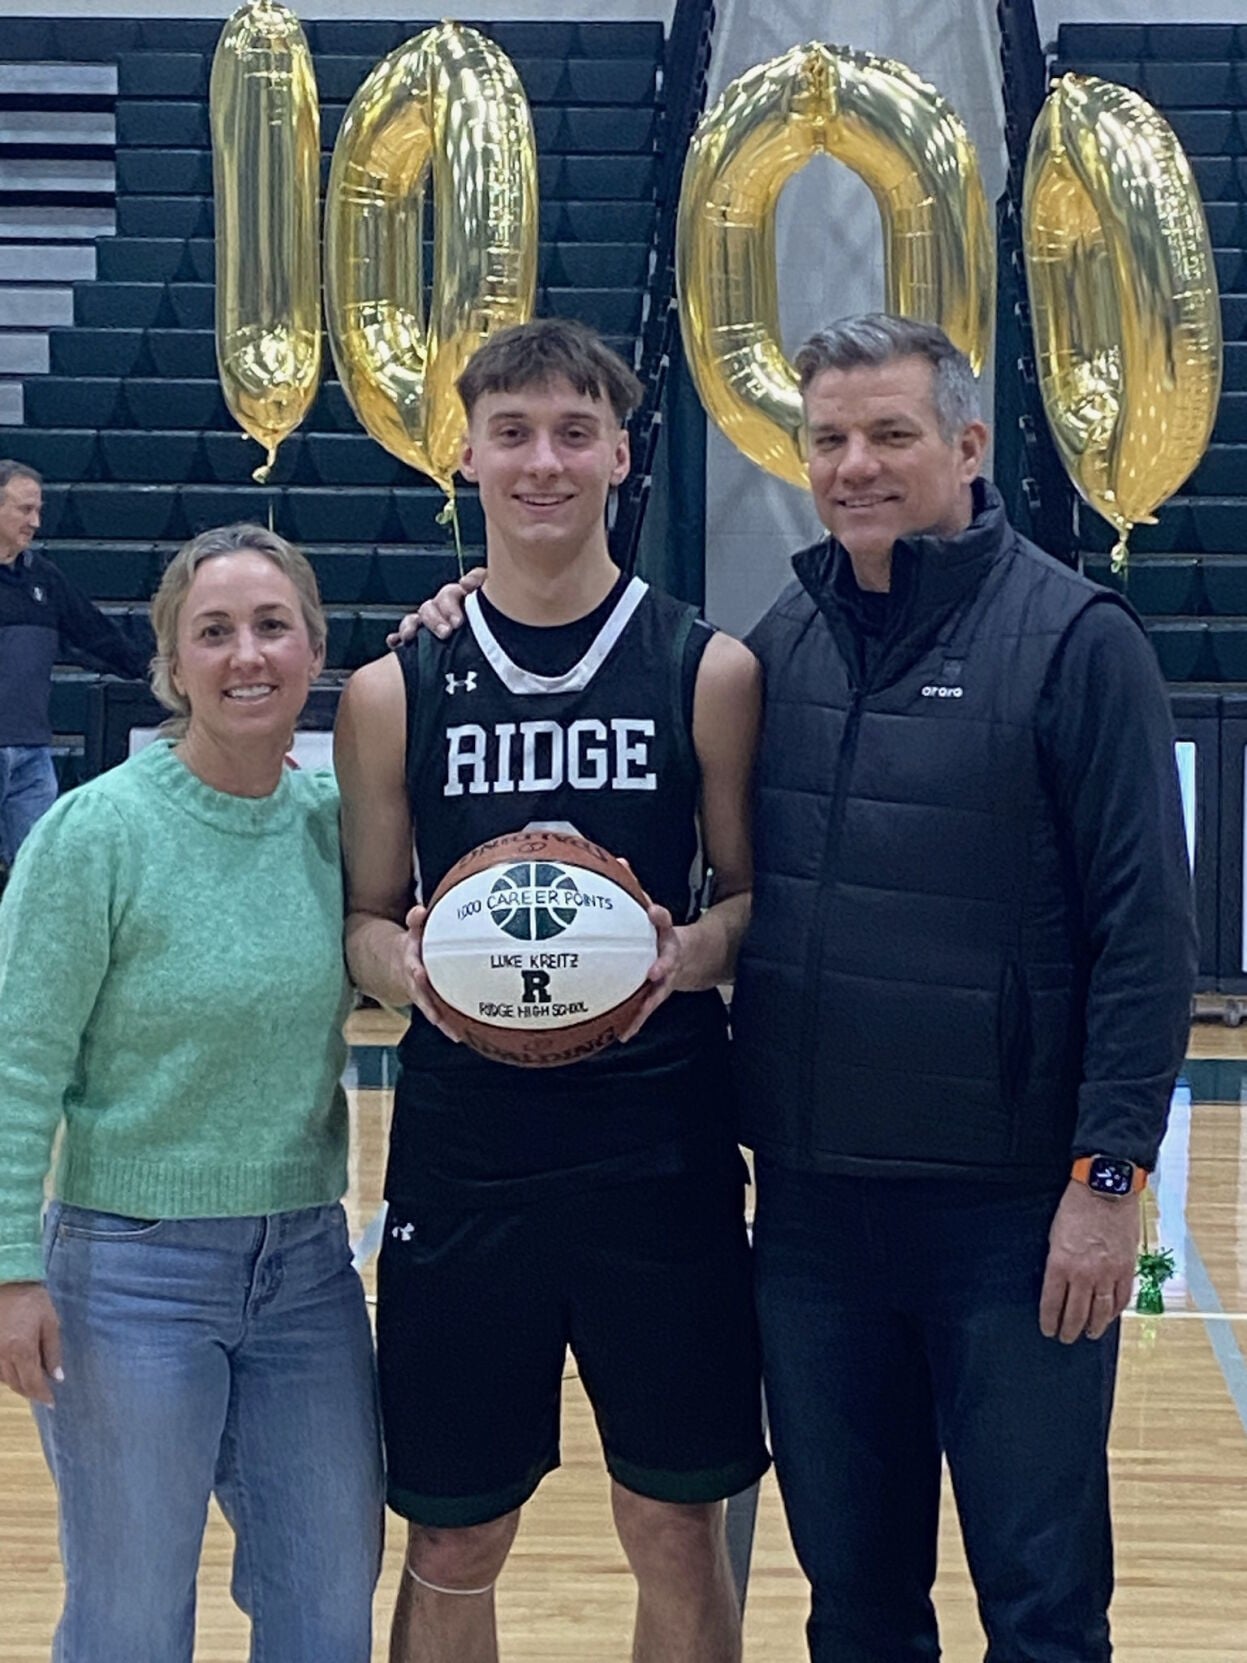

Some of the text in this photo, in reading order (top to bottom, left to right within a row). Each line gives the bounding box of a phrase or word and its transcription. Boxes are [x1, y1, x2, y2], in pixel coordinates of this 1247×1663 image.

[443, 718, 658, 796] RIDGE
[486, 889, 560, 910] CAREER
[490, 952, 579, 969] LUKE KREITZ
[521, 969, 552, 1003] R
[517, 1004, 550, 1018] HIGH
